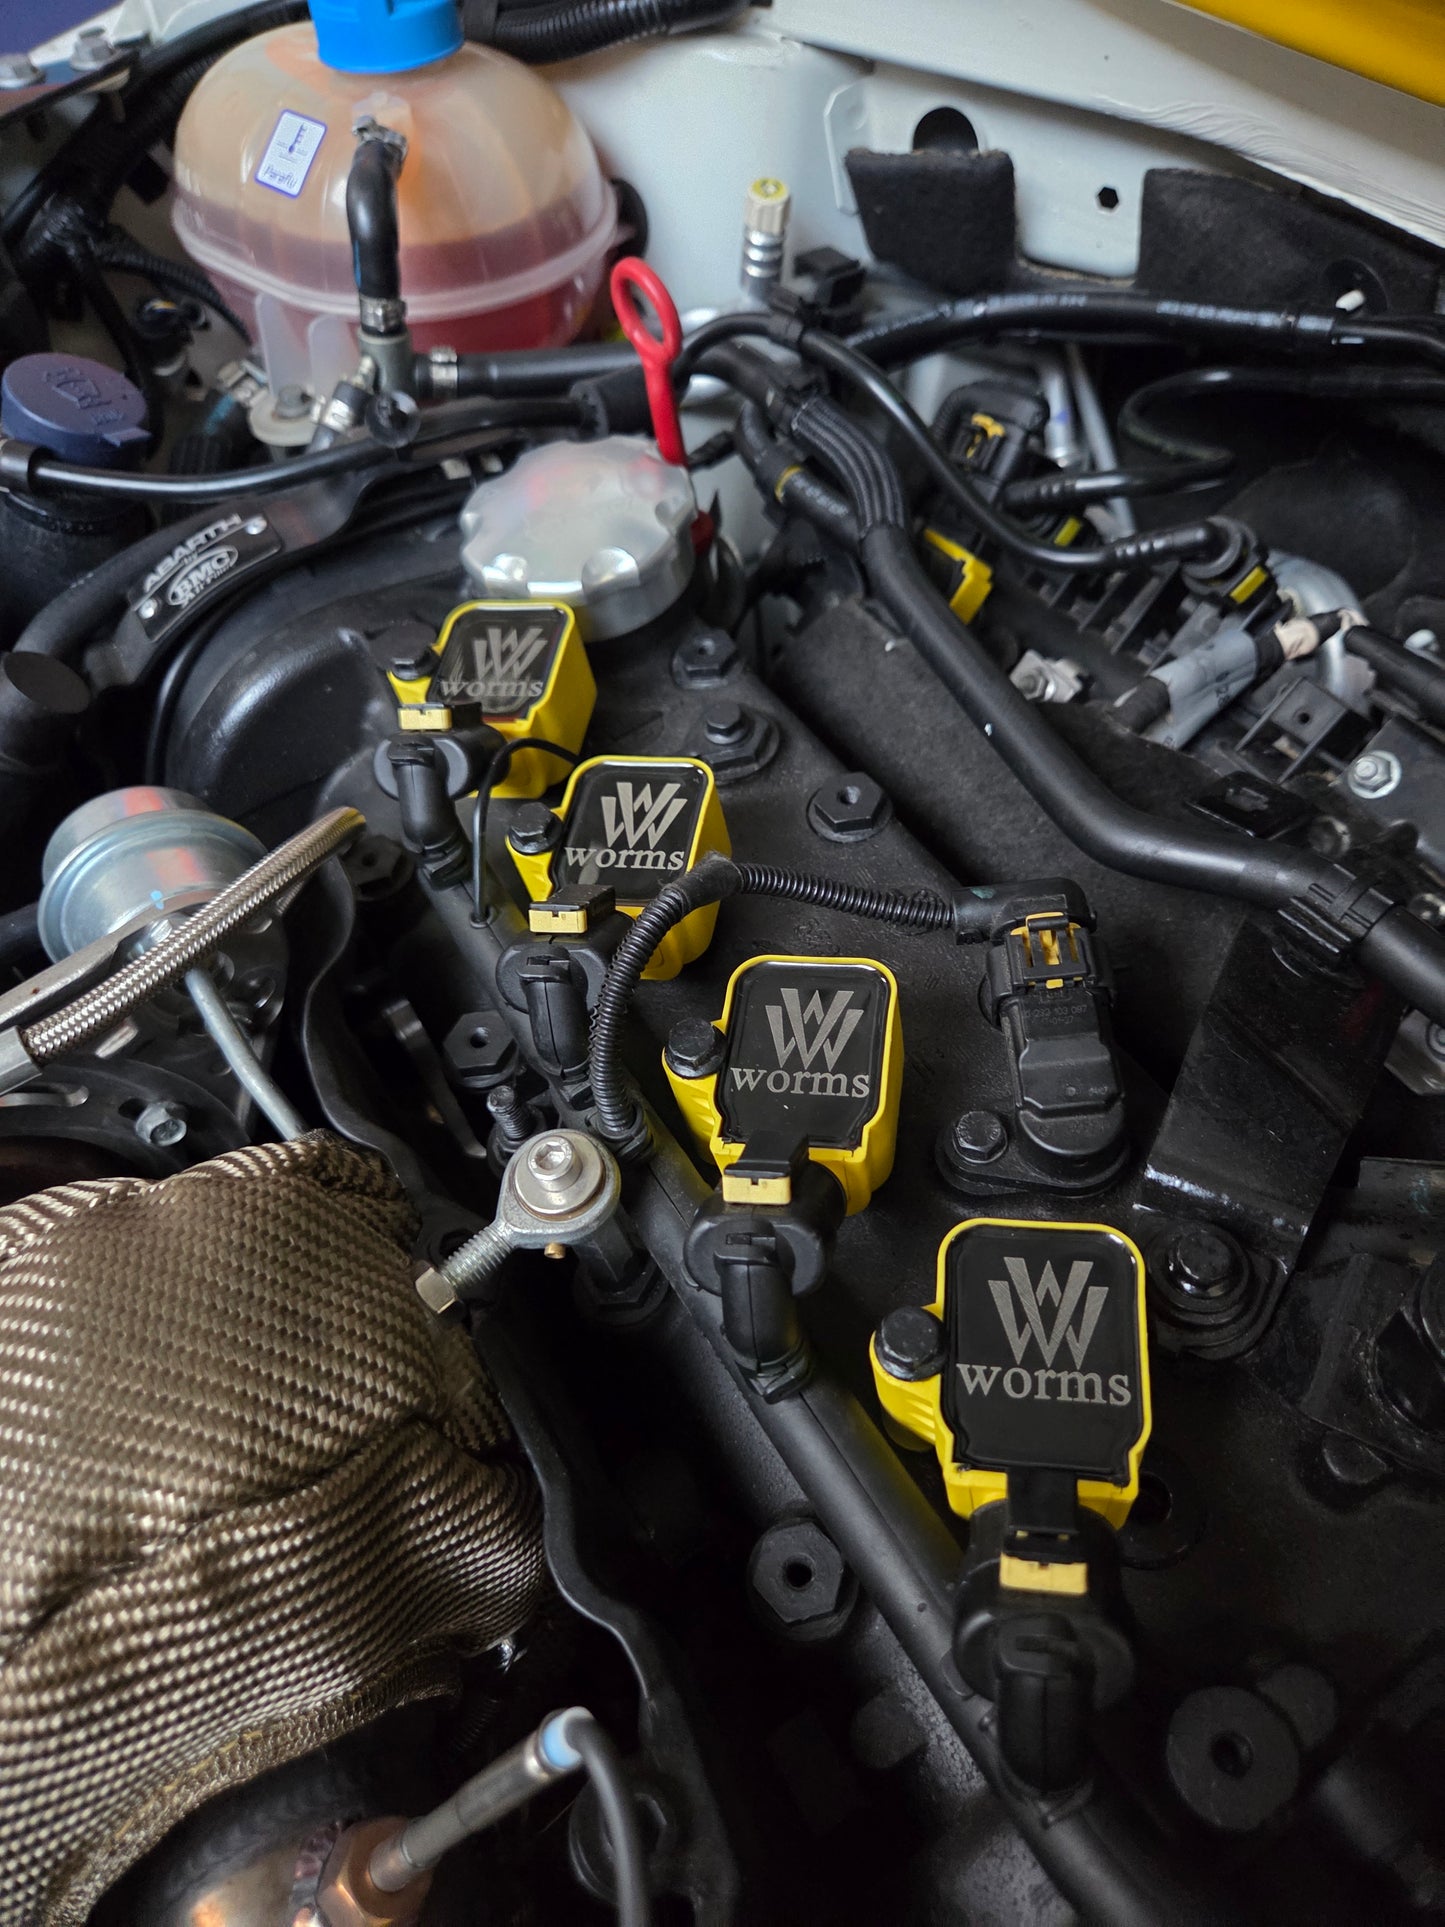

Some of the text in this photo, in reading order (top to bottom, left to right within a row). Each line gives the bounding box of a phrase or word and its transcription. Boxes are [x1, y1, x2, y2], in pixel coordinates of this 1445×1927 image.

[143, 513, 242, 593] ABARTH
[175, 551, 230, 601] BMC
[440, 681, 544, 697] worms
[564, 847, 685, 870] worms
[730, 1067, 870, 1098] worms
[956, 1363, 1132, 1406] worms
